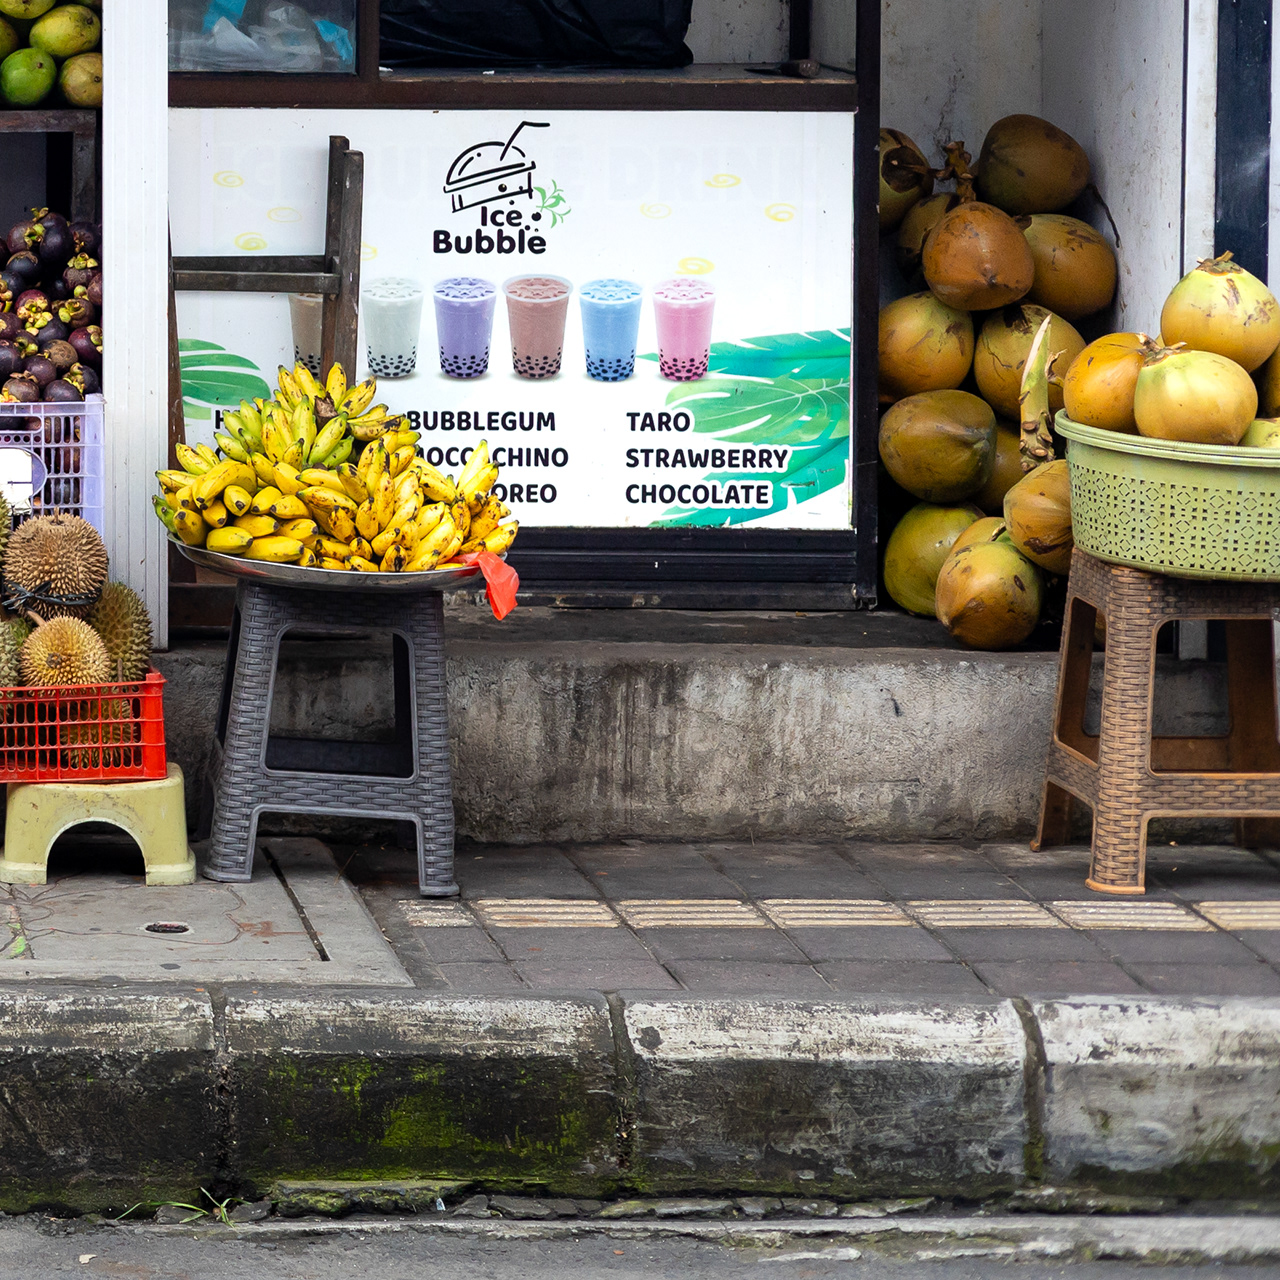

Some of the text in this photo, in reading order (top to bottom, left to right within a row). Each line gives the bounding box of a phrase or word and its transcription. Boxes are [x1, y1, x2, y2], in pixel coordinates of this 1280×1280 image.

[481, 205, 523, 227] Ice
[433, 228, 547, 254] Bubble
[407, 410, 556, 431] BUBBLEGUM
[626, 411, 691, 432] TARO
[416, 447, 569, 468] OCCCHINO
[626, 448, 788, 468] STRAWBERRY
[491, 483, 557, 503] OREO
[625, 484, 769, 504] CHOCOLATE
